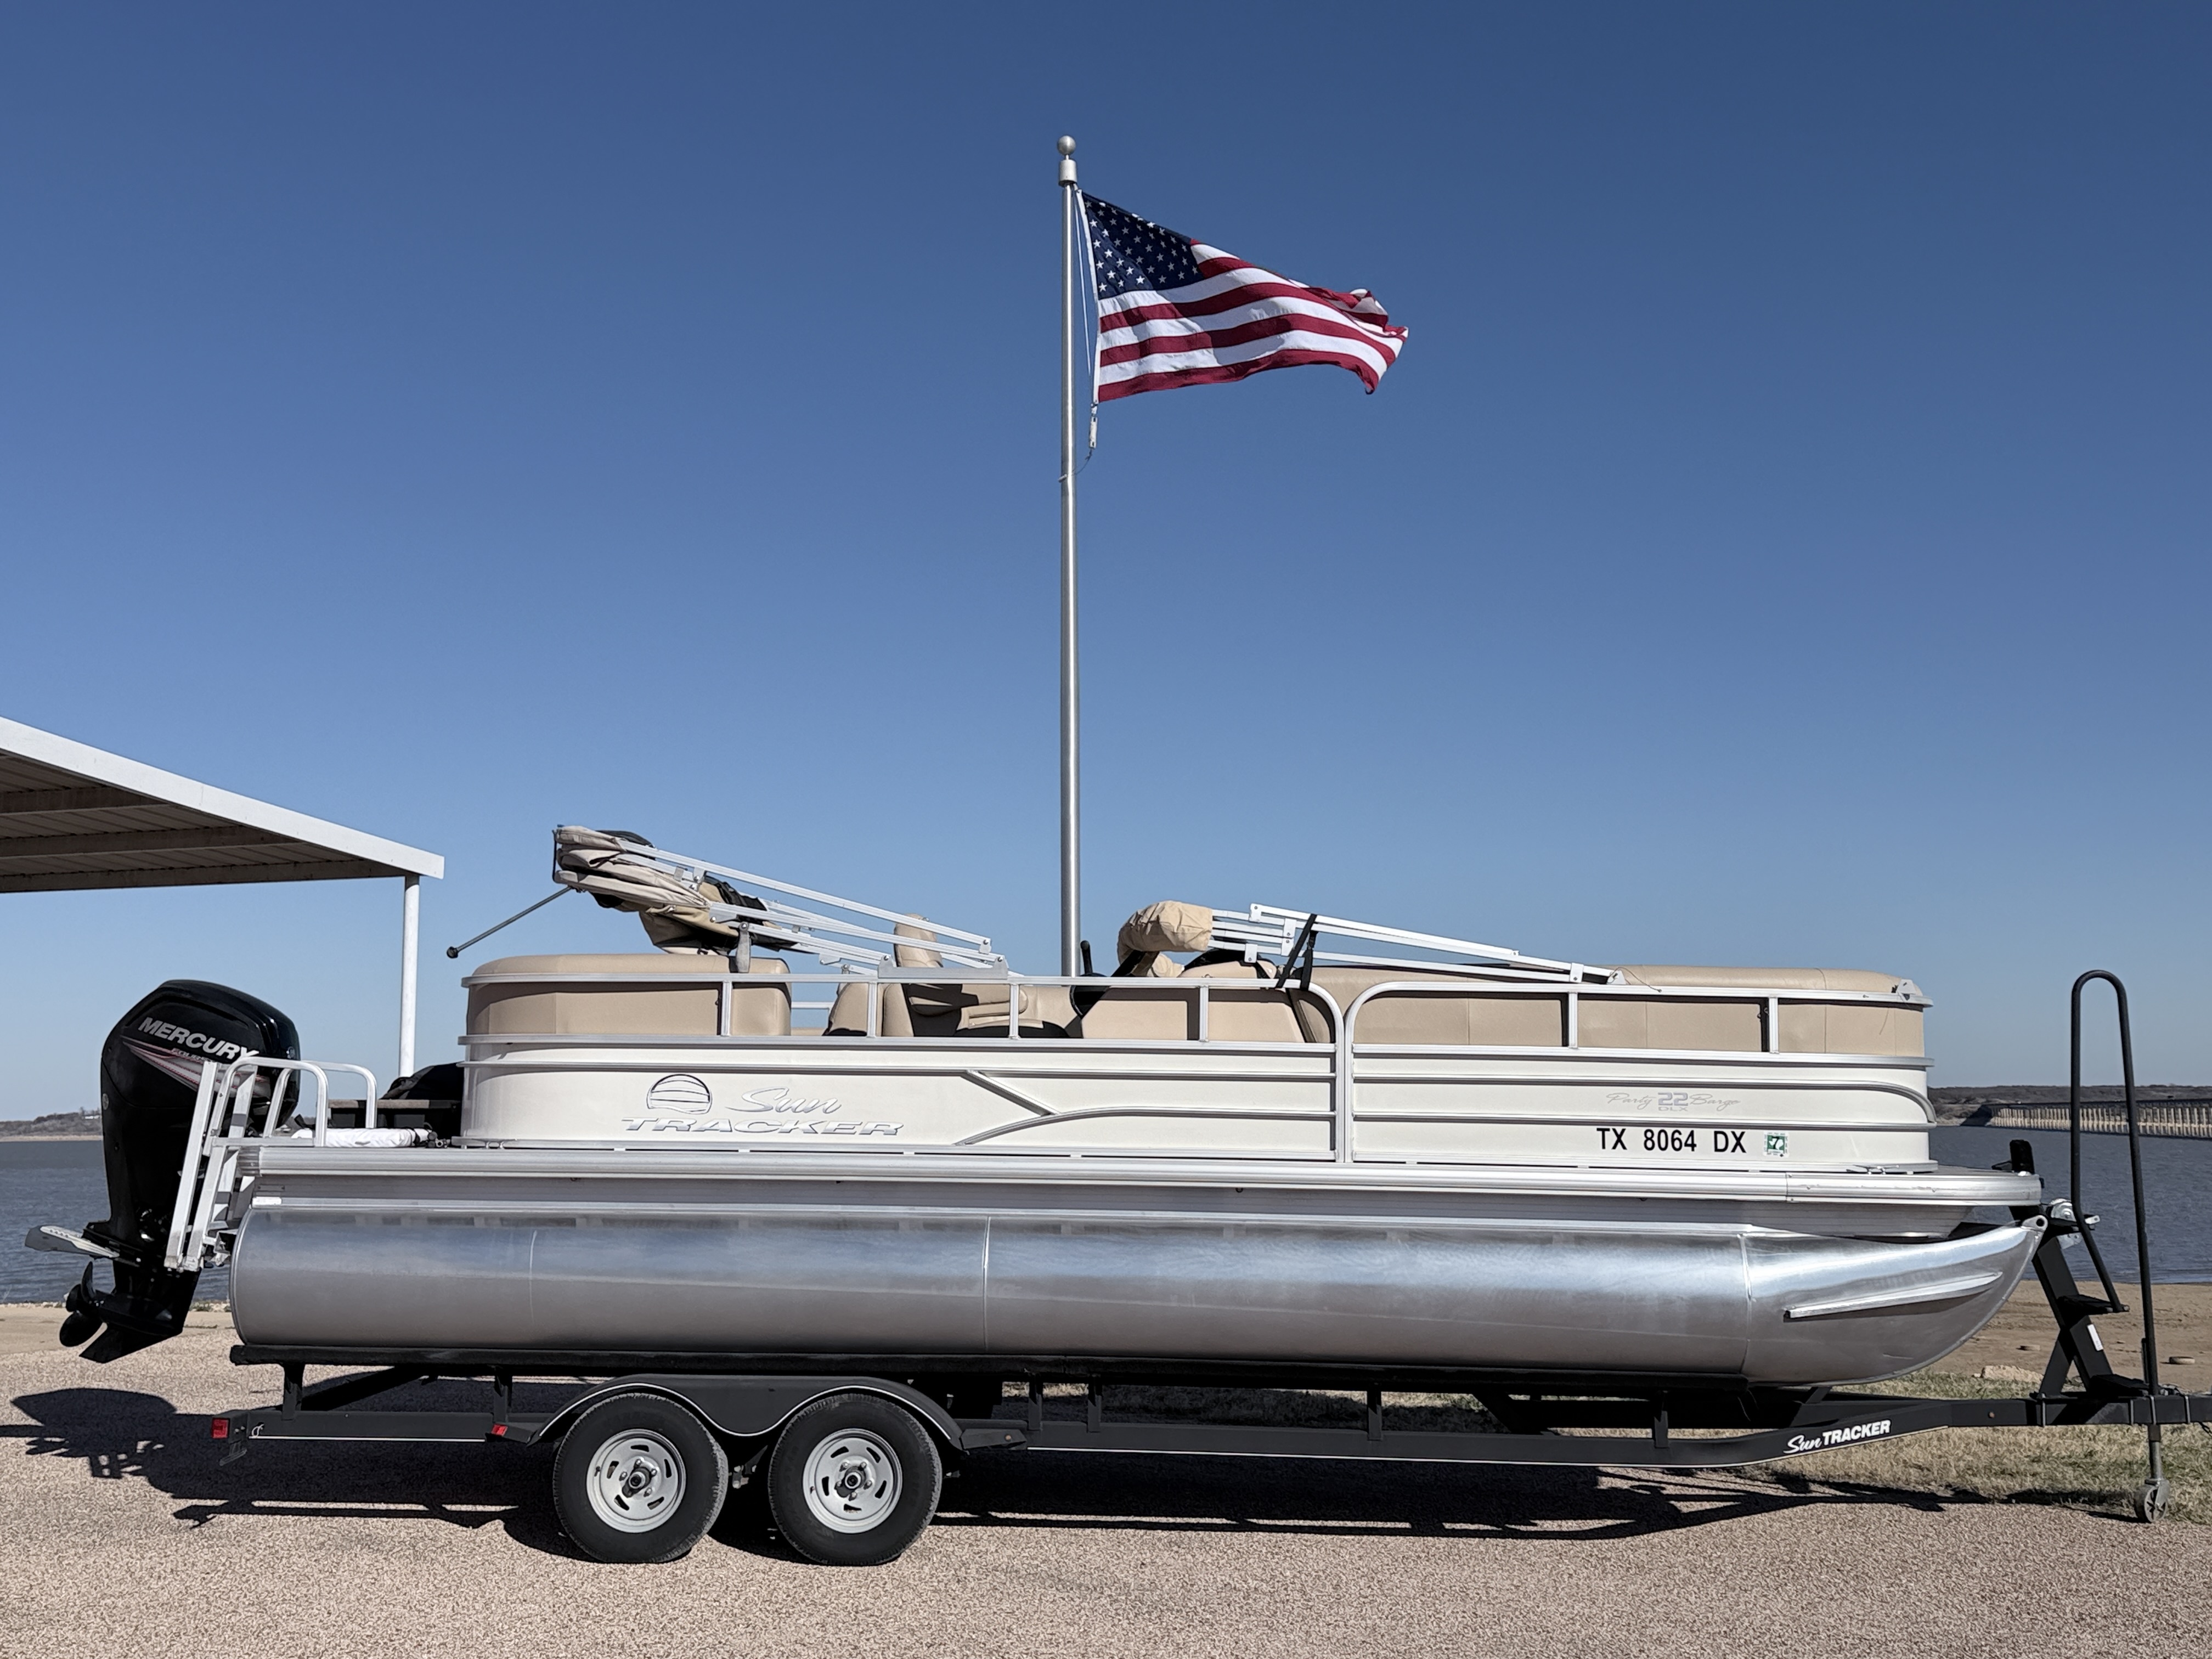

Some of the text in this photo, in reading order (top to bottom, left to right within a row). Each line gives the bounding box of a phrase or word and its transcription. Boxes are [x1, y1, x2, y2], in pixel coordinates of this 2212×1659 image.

[138, 1017, 259, 1059] MERCURY
[725, 1086, 842, 1114] Sun
[1606, 1092, 1741, 1111] Party 22 Barge
[621, 1117, 905, 1136] TRACKER
[1596, 1127, 1628, 1150] TX
[1643, 1128, 1697, 1152] 8064
[1713, 1130, 1747, 1153] DX
[1783, 1420, 1891, 1454] Sun TRACKER
